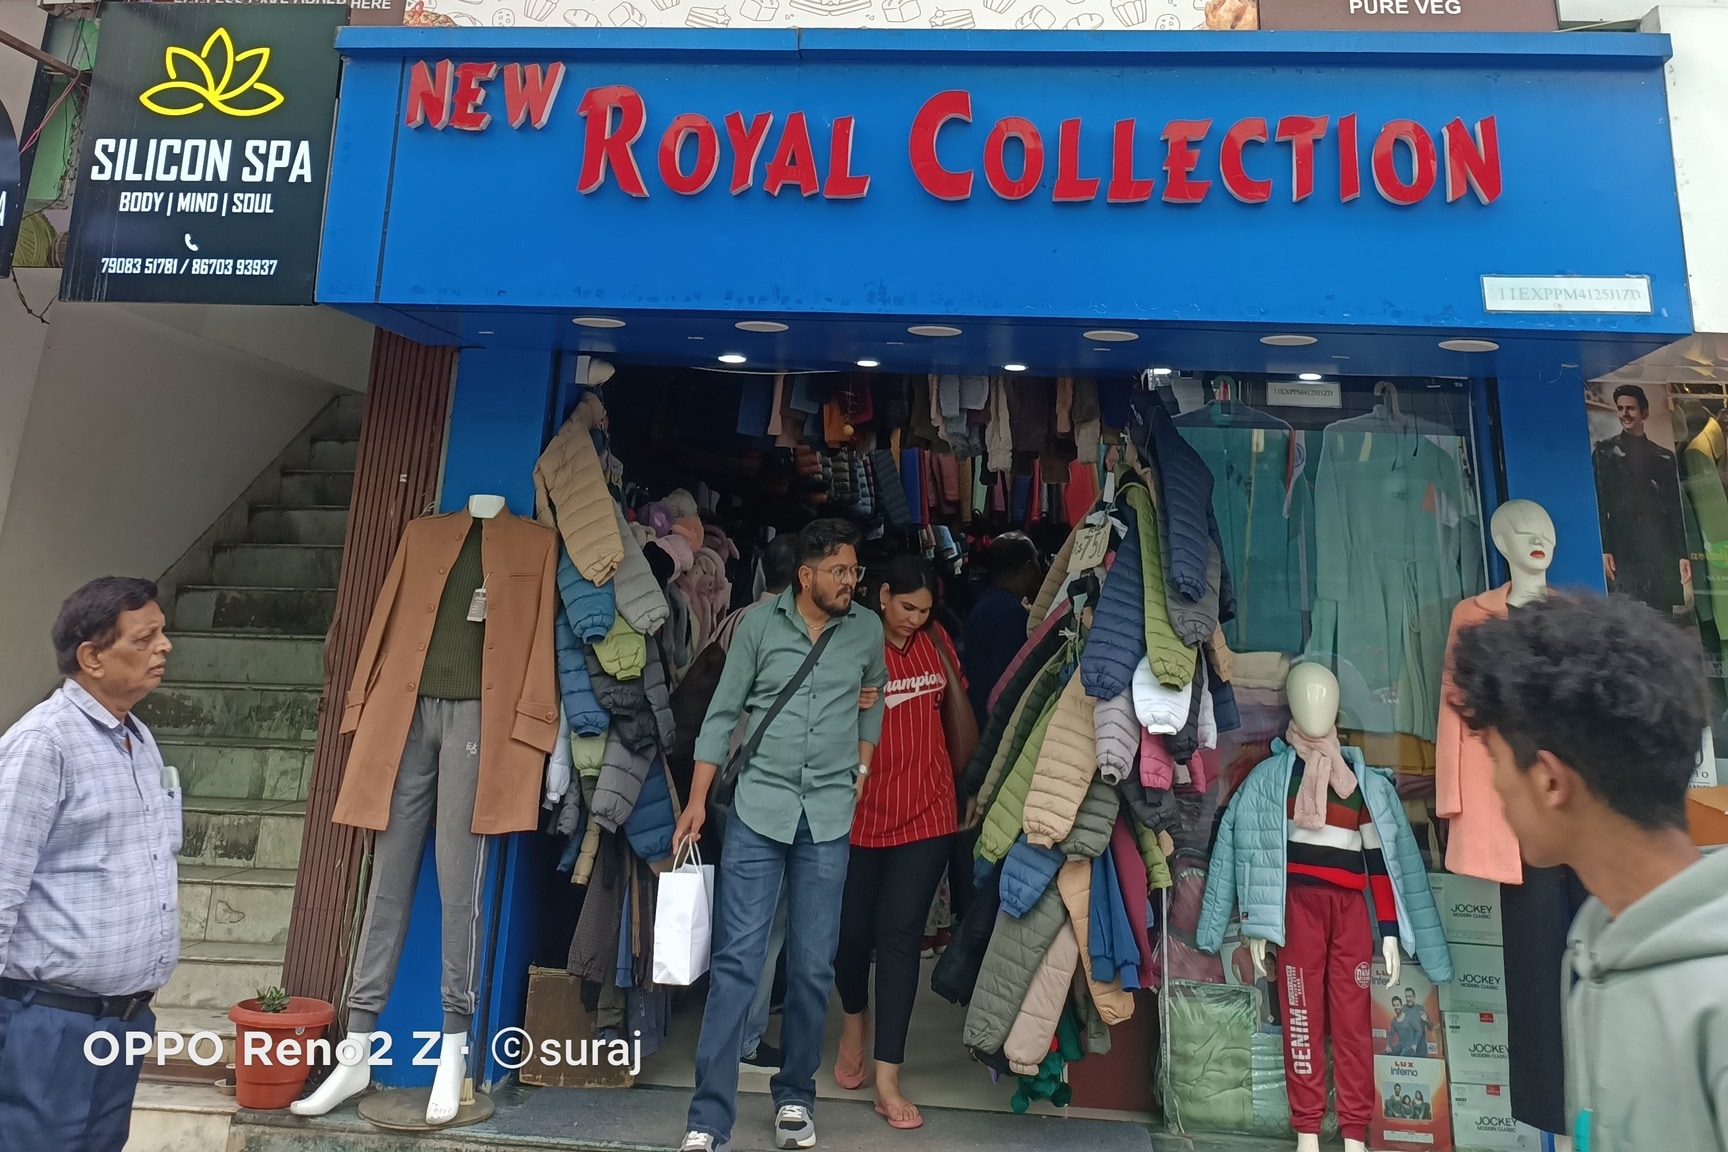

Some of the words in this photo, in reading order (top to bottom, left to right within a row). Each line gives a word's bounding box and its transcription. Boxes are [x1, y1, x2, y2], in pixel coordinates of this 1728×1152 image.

[1349, 0, 1409, 15] PURE
[1414, 0, 1462, 15] VEG
[404, 58, 566, 132] NEW
[576, 84, 871, 200] ROYAL
[908, 89, 1503, 206] COLLECTION
[90, 138, 232, 182] SILICON
[241, 139, 312, 183] SPA
[119, 191, 164, 213] BODY
[177, 192, 218, 213] MIND
[232, 193, 274, 213] SOUL
[101, 258, 142, 274] 79083
[144, 258, 178, 275] 51781
[191, 258, 233, 275] 86703
[235, 259, 278, 276] 93937
[1450, 904, 1493, 914] JOCKEY
[1458, 973, 1501, 985] JOCKEY
[1289, 1008, 1312, 1075] DENIM
[1390, 1067, 1418, 1077] Inferno
[1475, 1116, 1518, 1127] JOCKEY
